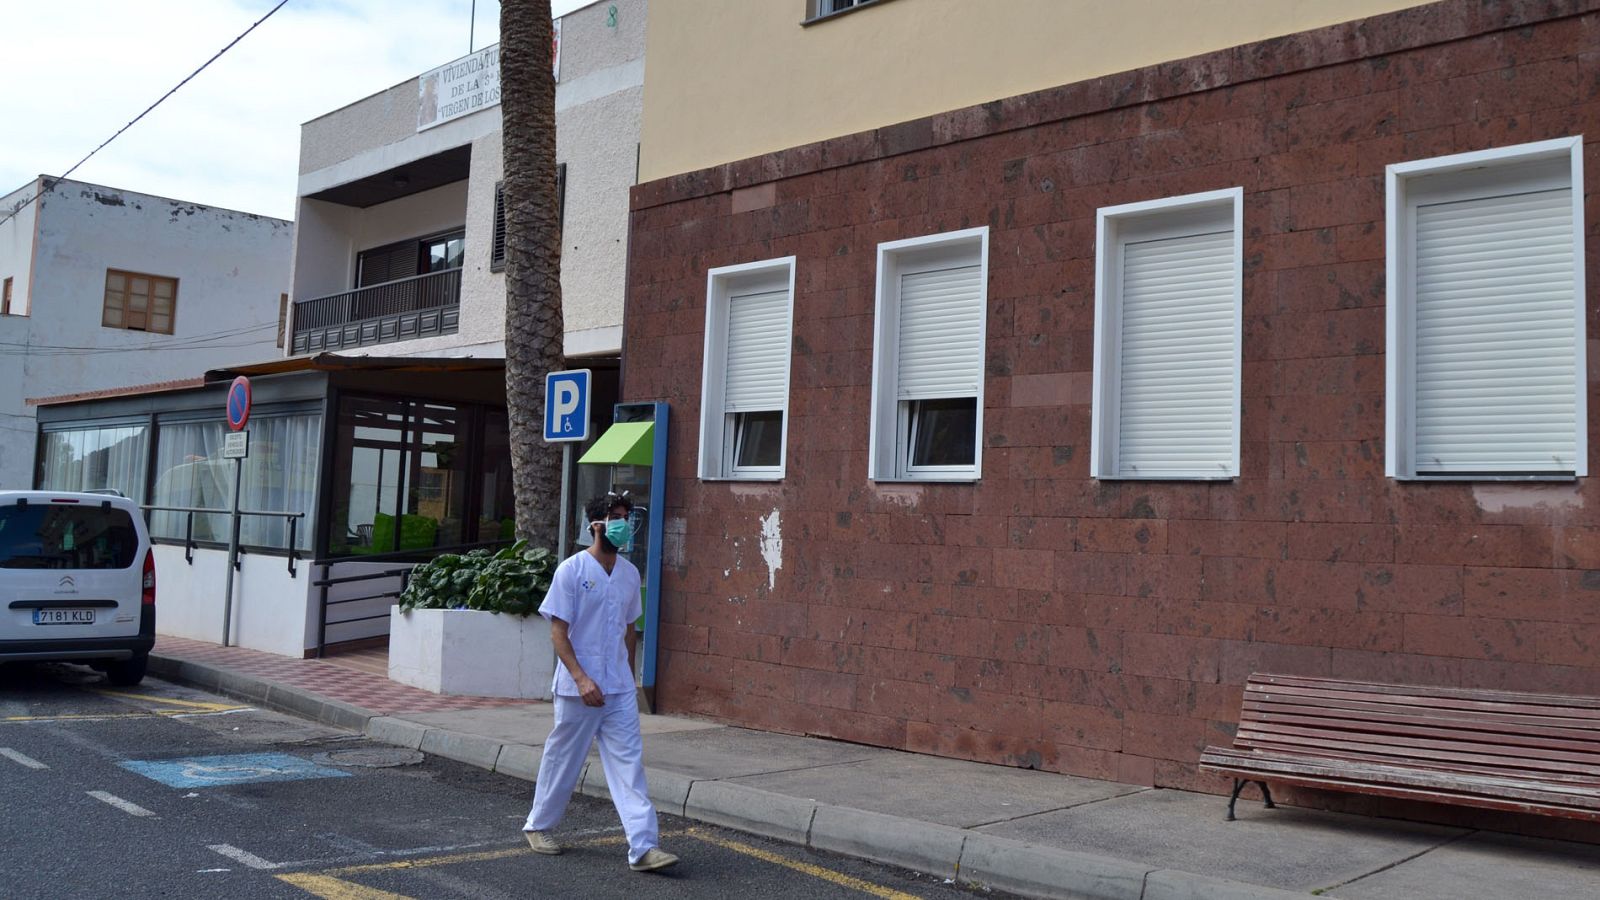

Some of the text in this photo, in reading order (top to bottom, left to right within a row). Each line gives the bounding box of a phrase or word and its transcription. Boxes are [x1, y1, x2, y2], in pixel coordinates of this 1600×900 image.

[451, 84, 464, 98] DE
[467, 79, 479, 92] LA
[472, 92, 483, 108] DE
[485, 86, 500, 104] LOS
[553, 380, 579, 433] P
[41, 611, 93, 620] 7181 KLD
